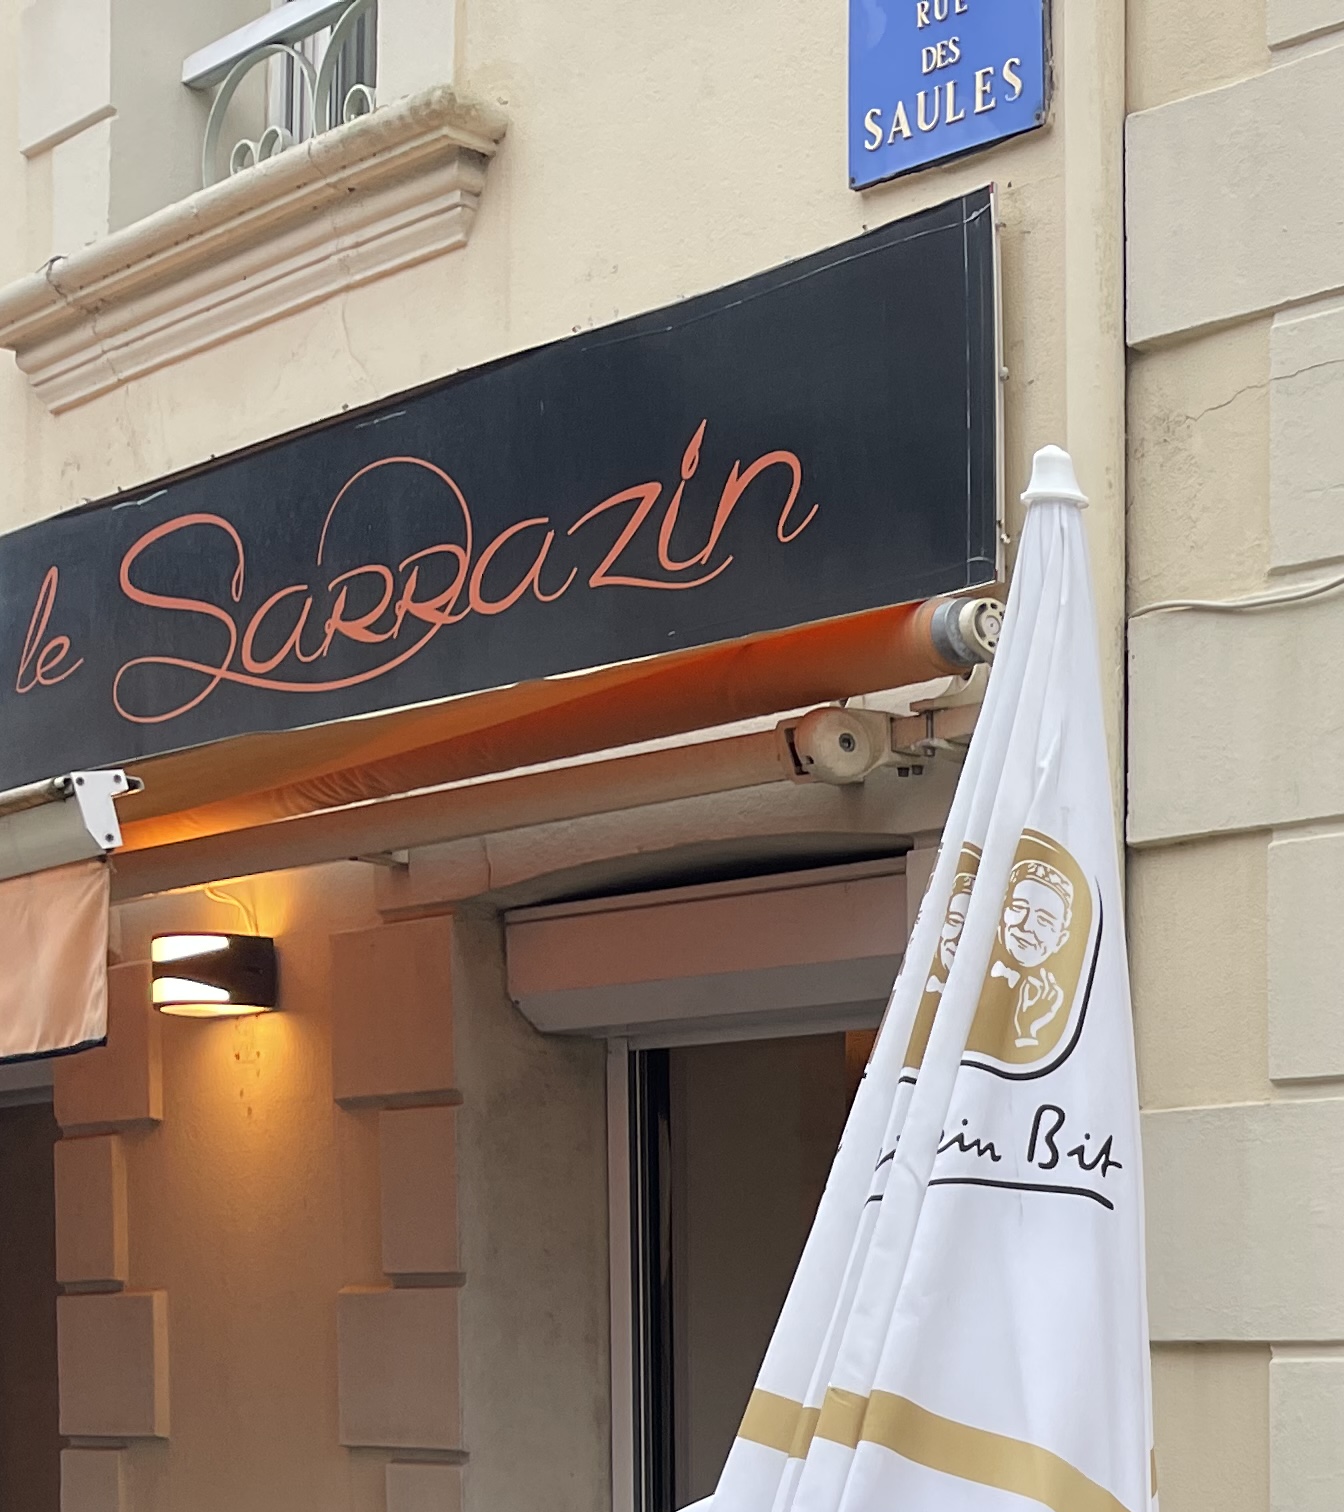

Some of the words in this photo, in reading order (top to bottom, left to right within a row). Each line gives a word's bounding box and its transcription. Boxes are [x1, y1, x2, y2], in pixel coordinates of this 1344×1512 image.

[916, 0, 968, 29] RUE
[921, 36, 961, 75] DES
[864, 57, 1023, 151] SAULES
[15, 565, 84, 694] le
[1027, 1104, 1123, 1178] Bit
